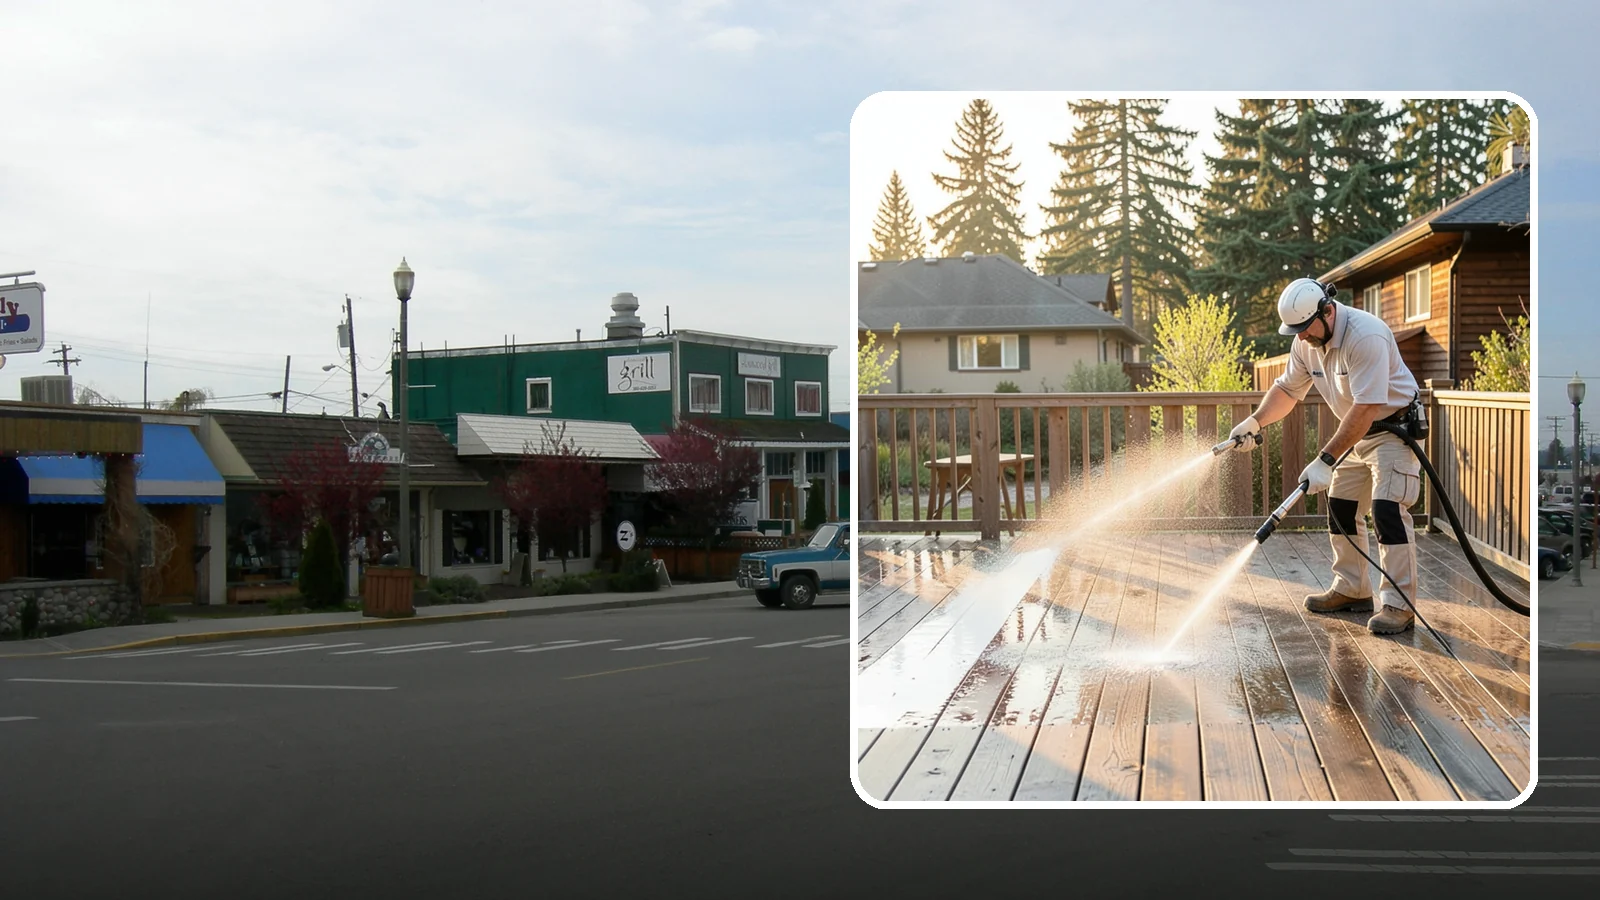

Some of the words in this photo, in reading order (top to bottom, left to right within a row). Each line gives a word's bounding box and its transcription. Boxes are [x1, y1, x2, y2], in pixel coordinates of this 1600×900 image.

[3, 338, 16, 346] Fries
[617, 355, 655, 392] grill
[619, 529, 634, 542] Z's
